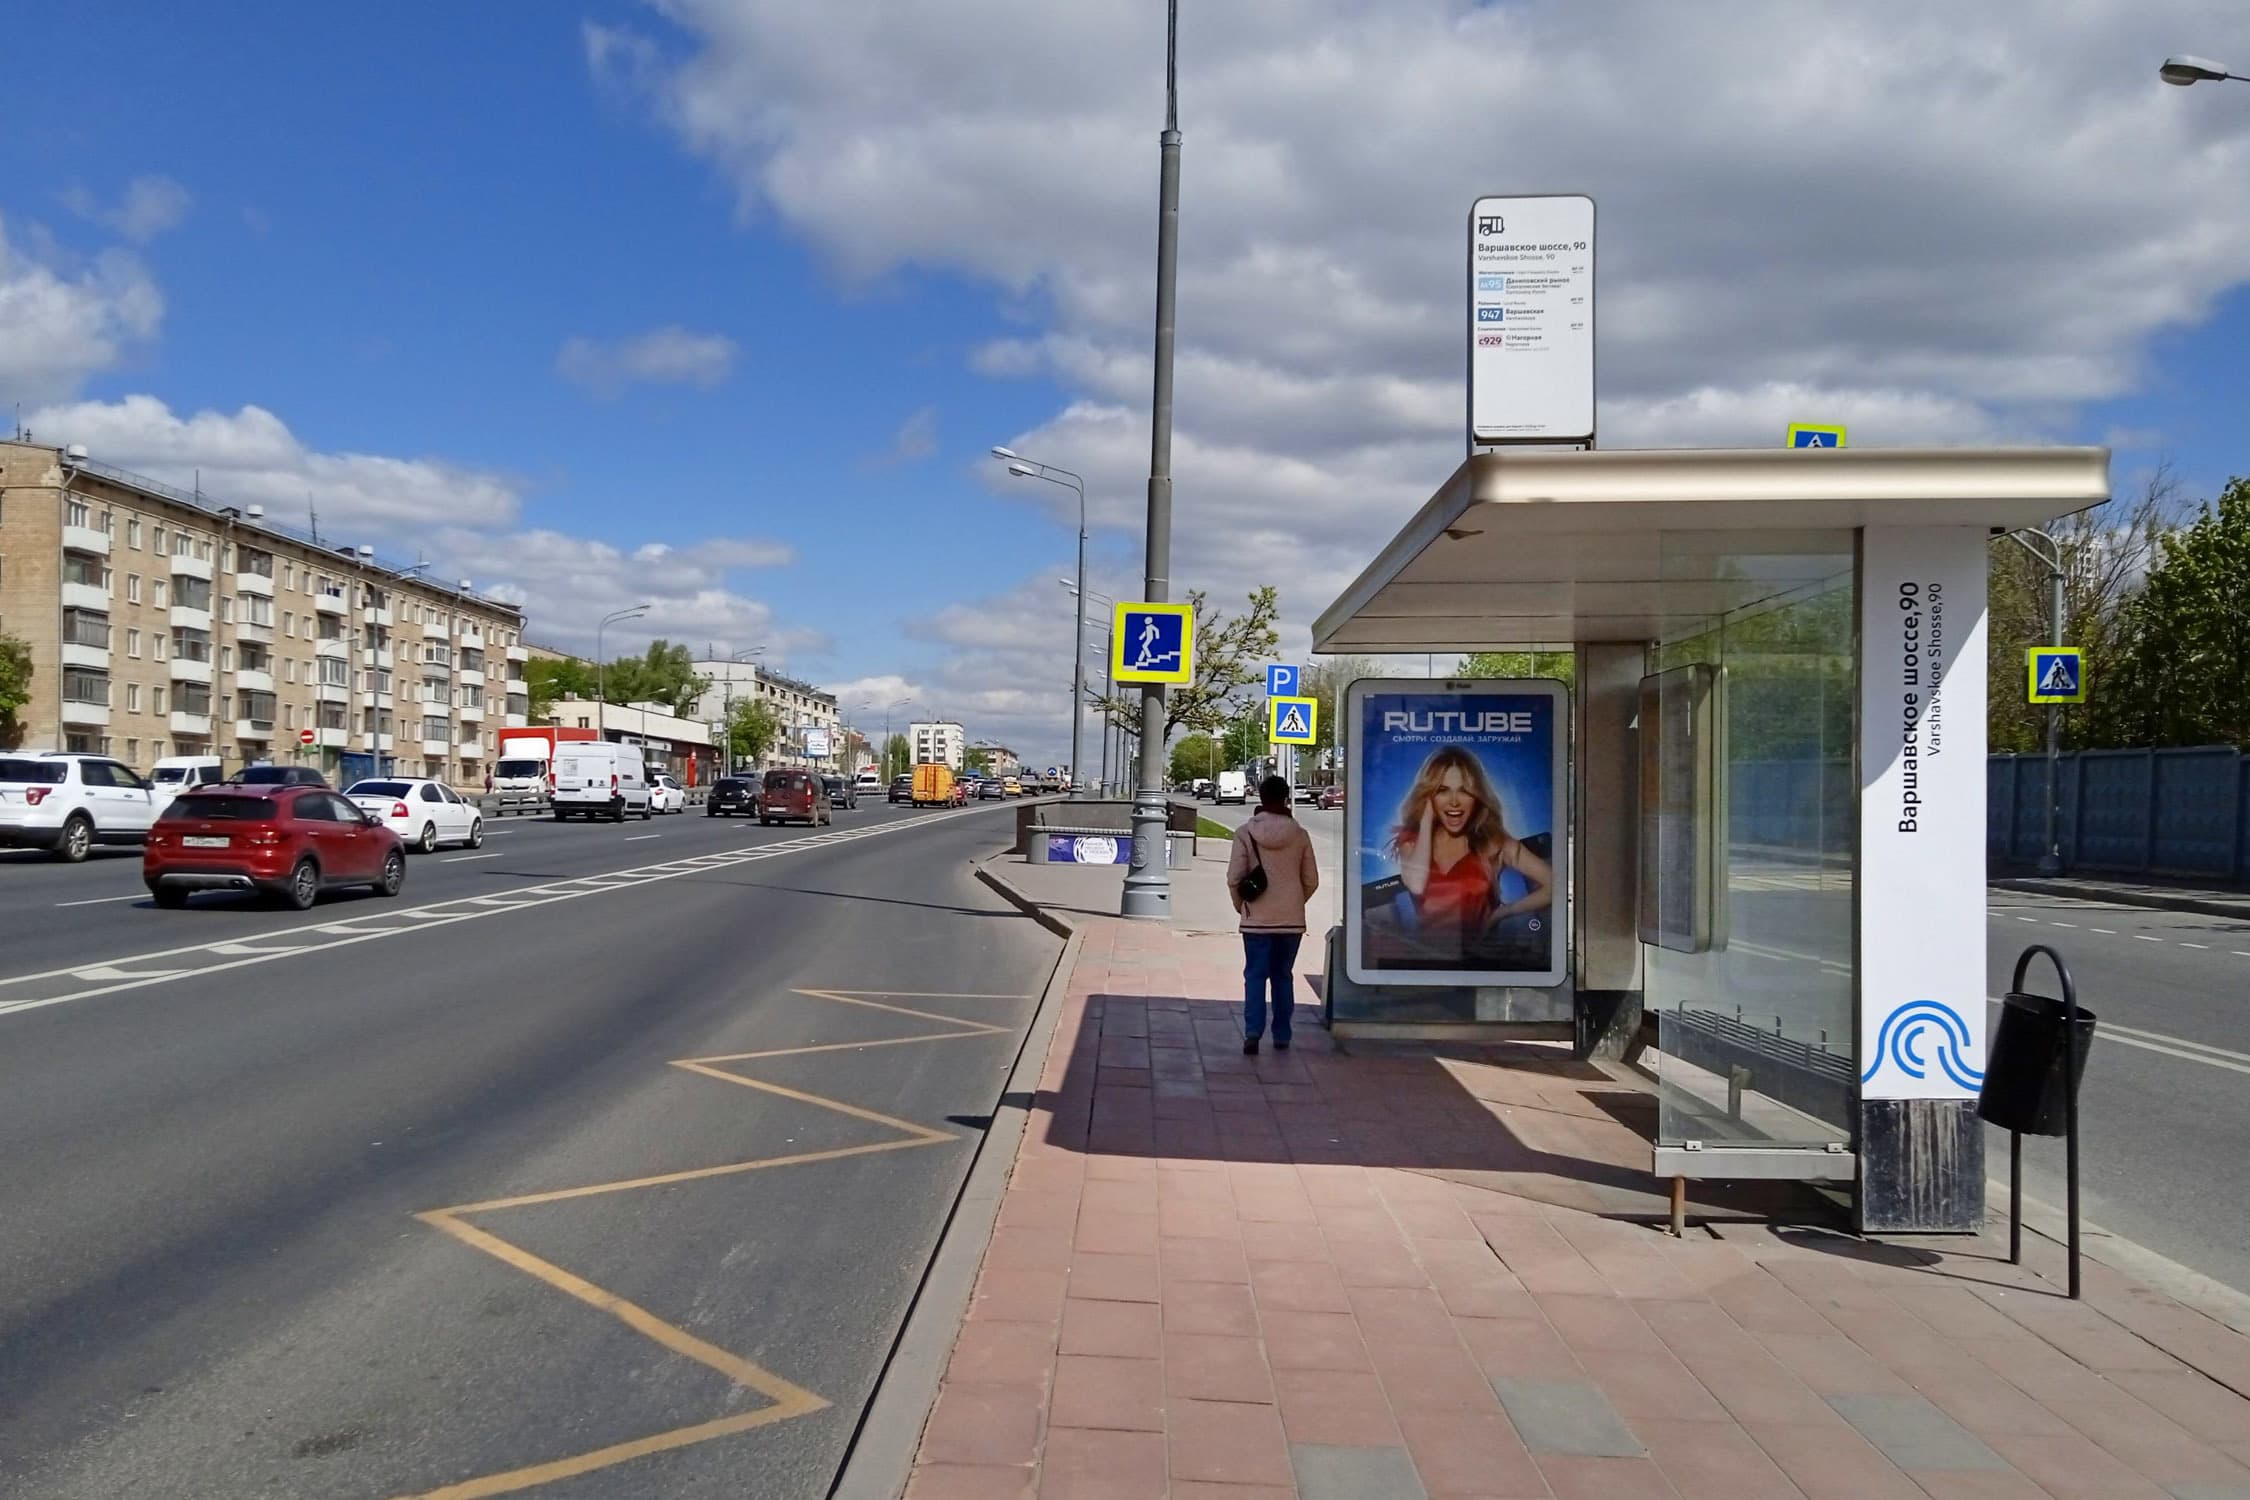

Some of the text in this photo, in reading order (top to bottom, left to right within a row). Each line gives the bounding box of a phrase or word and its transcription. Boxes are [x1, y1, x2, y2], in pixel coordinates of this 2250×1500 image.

[1478, 241, 1586, 253] Варшавское шоссе, 90
[1481, 310, 1501, 320] 947
[1478, 336, 1502, 345] с929
[1273, 668, 1292, 693] P
[1927, 661, 1942, 757] Varshavskoe
[1384, 711, 1533, 733] RUTUBE
[1898, 692, 1922, 833] Варшавское
